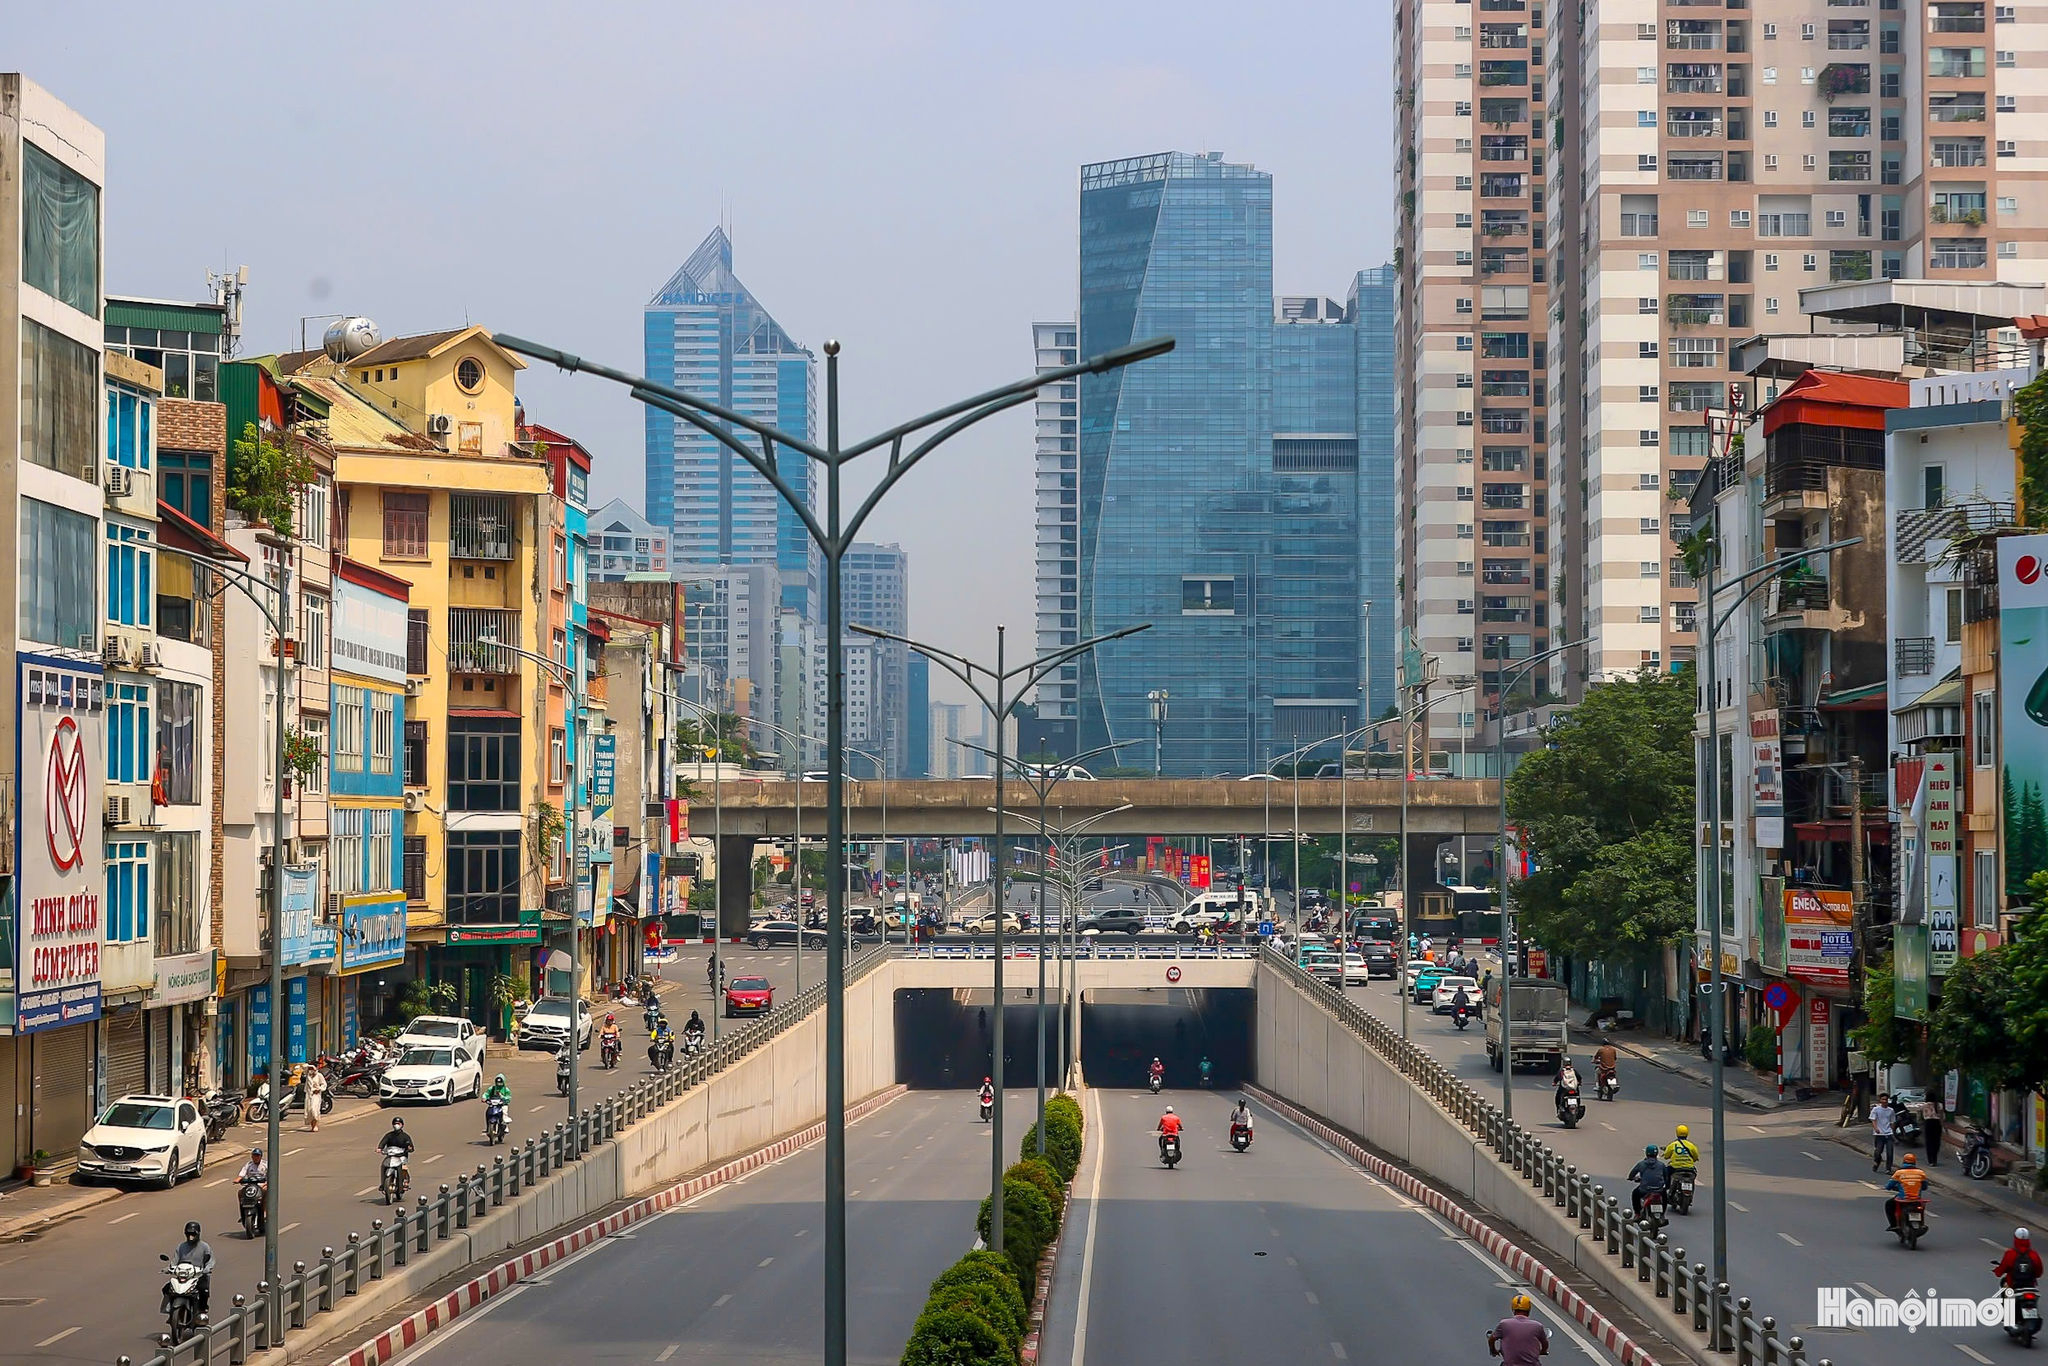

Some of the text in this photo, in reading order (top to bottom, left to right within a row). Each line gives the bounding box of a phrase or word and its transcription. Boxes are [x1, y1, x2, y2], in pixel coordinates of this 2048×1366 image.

[594, 794, 613, 807] 80H
[34, 885, 98, 935] MINH QUÂN
[1822, 935, 1851, 944] HOTEL
[33, 942, 99, 983] COMPUTER
